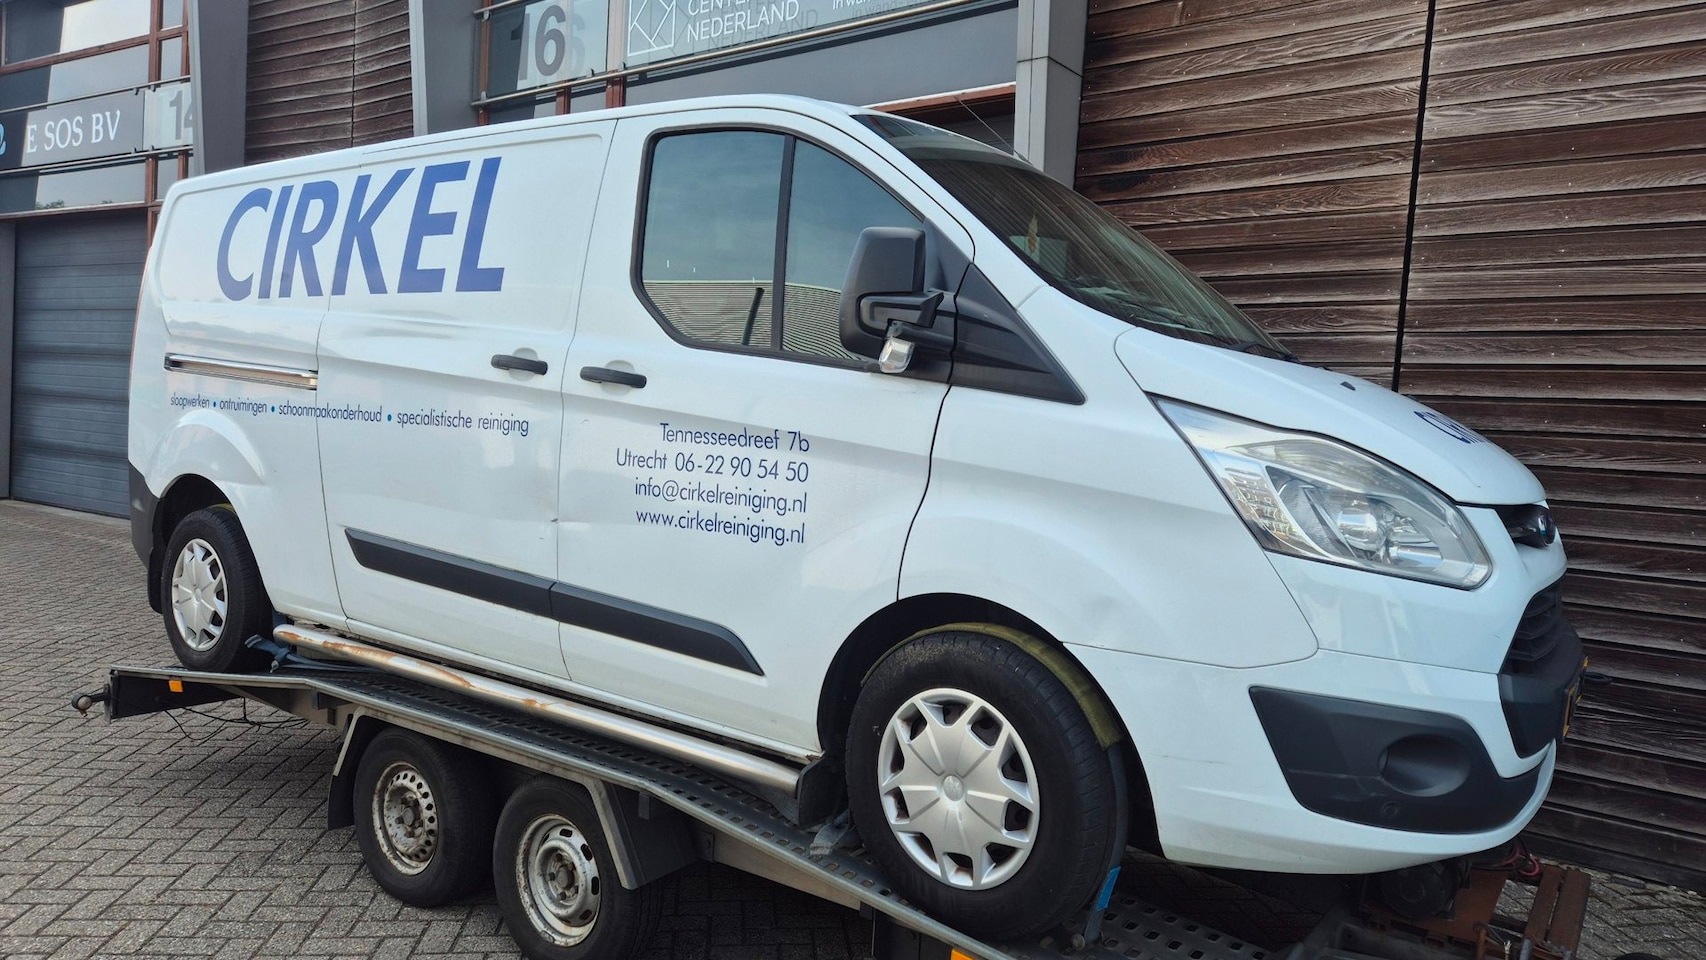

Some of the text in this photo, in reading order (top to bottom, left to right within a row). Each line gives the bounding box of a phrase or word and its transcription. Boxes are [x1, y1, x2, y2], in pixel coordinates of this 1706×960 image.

[687, 0, 800, 43] NEDERLAND
[510, 4, 567, 81] 16
[44, 116, 84, 151] SOS
[91, 110, 121, 144] BV
[216, 156, 505, 301] CIRKEL
[170, 392, 529, 437] sloopwerken ontruimingen schoonmaakonderhoud specialistische reiniging
[659, 422, 810, 452] Tennesseedreef 7b
[616, 448, 668, 470] Utrecht
[730, 456, 751, 477] 90
[757, 459, 780, 480] 54
[785, 461, 809, 483] 50
[635, 477, 807, 516] info@cirkelreiniging.nl
[635, 510, 806, 546] www.cirkelreiniging.nl
